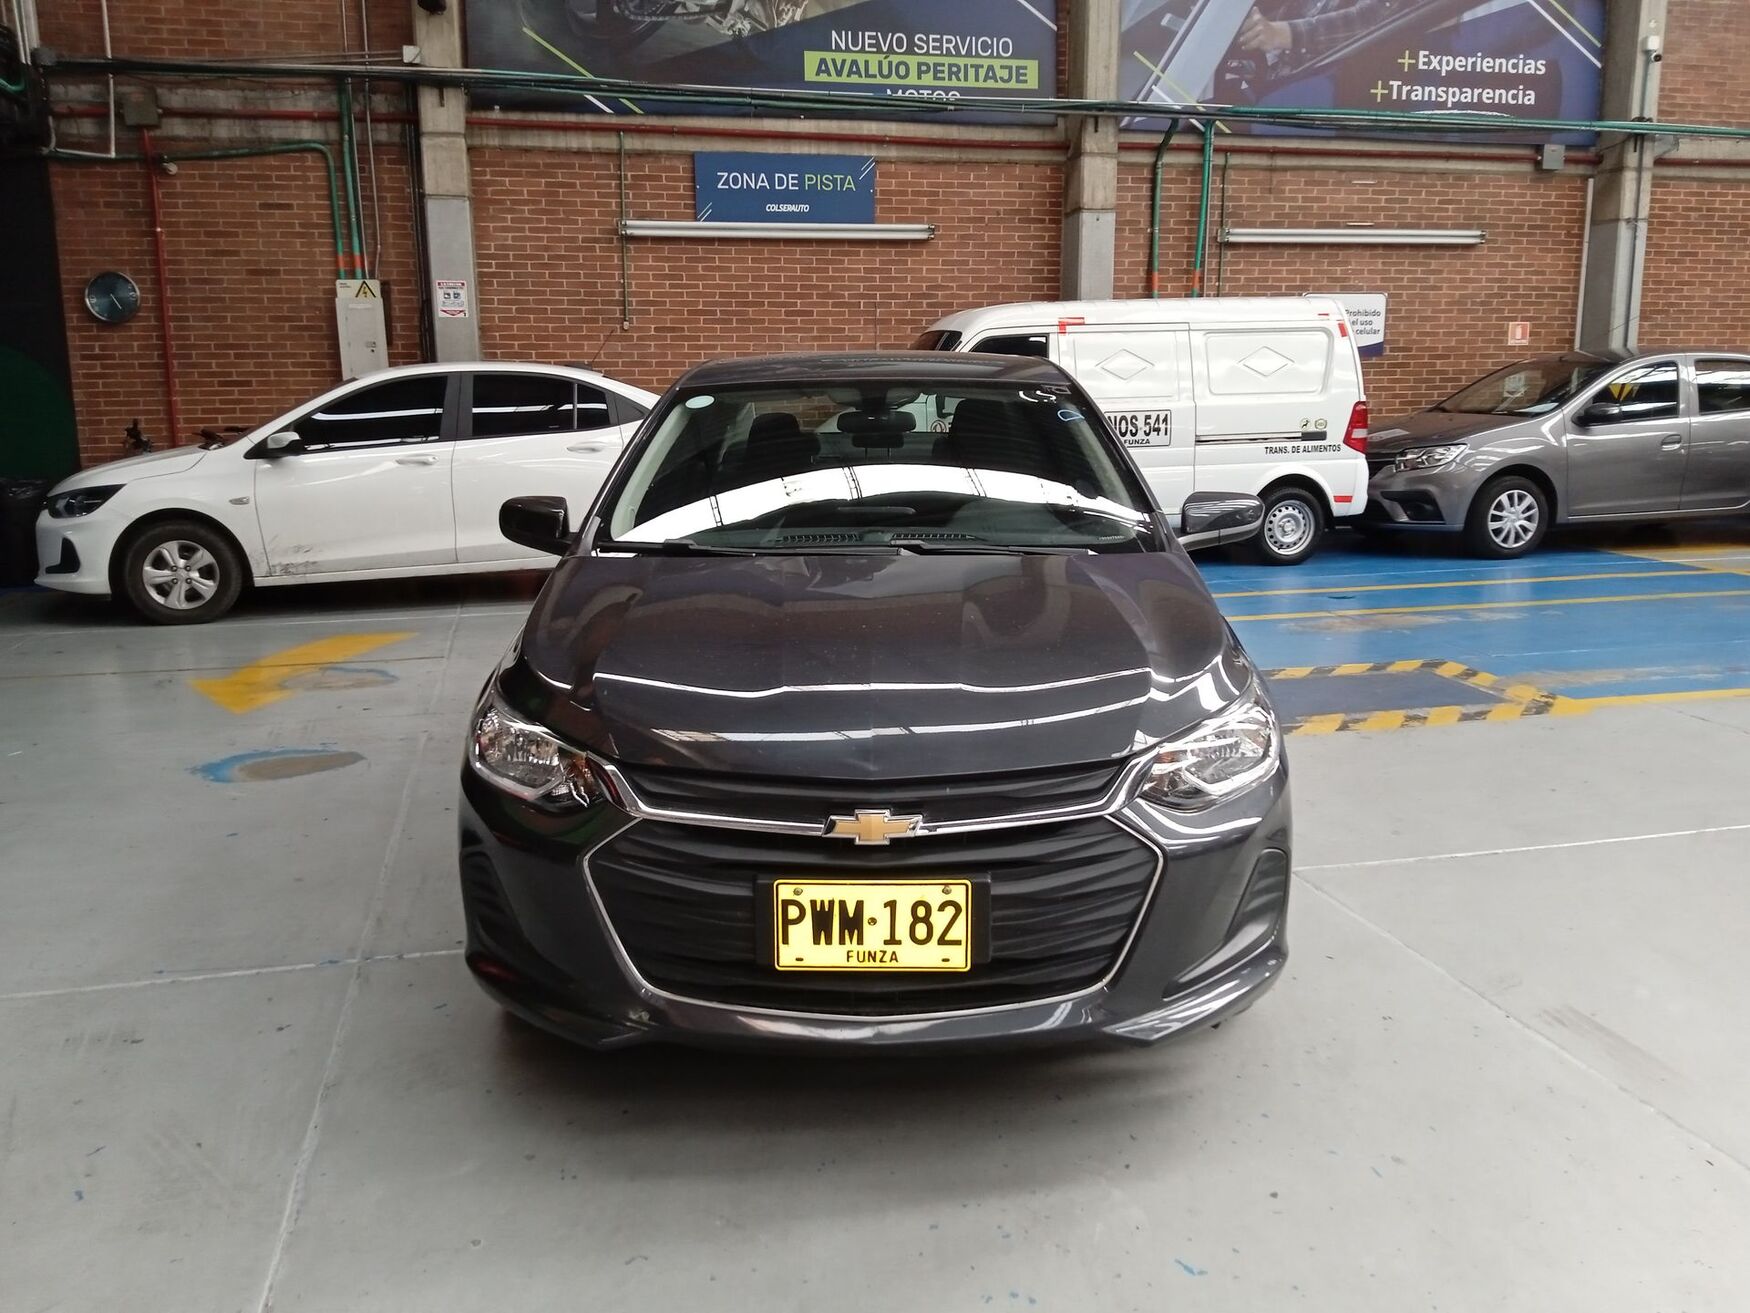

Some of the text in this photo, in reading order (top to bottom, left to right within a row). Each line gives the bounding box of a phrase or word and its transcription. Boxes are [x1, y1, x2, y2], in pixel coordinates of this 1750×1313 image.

[831, 30, 1013, 57] NUEVO SERVICIO
[815, 54, 1029, 84] AVALÚO PERITAJE
[717, 172, 856, 191] ZONA DE PISTA
[766, 203, 810, 213] COLSERAUTO
[1356, 327, 1380, 335] celular
[1265, 444, 1341, 455] TRANS. DE ALIMENTOS
[847, 950, 899, 963] FUNZA
